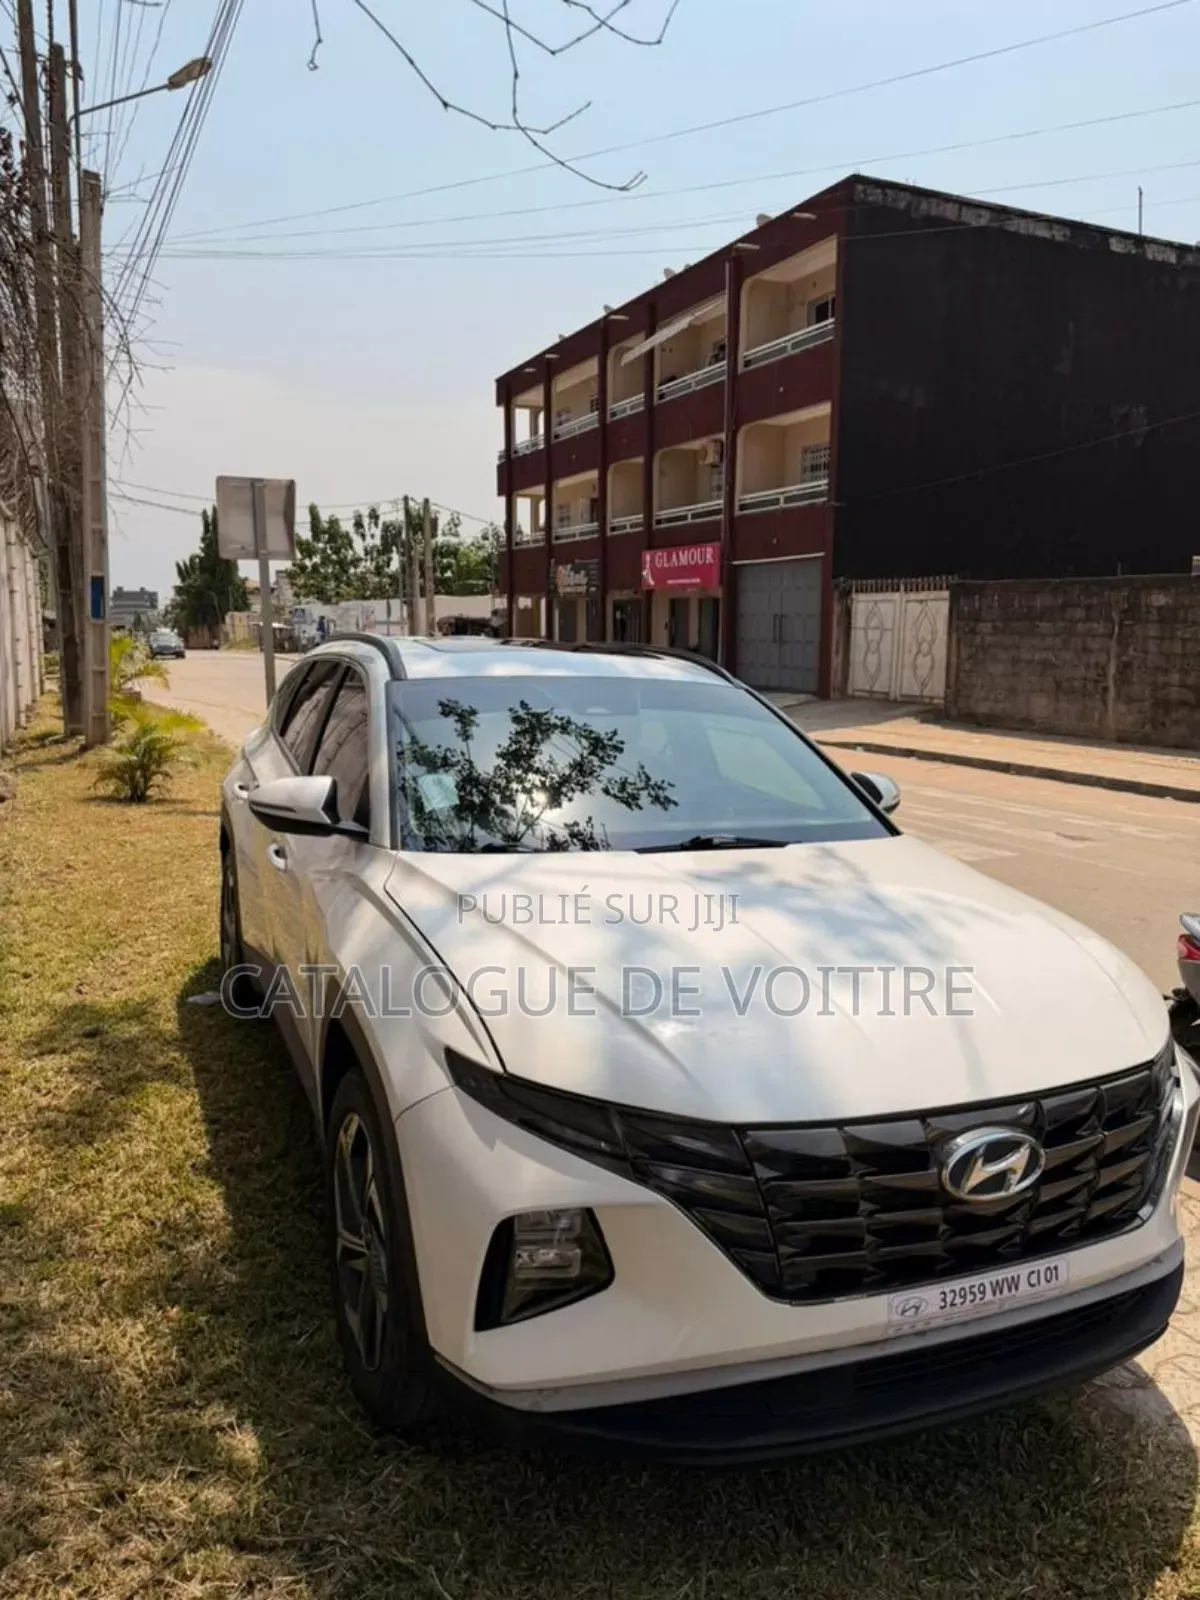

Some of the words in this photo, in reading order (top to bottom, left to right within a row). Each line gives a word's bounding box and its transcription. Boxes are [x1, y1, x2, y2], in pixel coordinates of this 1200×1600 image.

[655, 547, 714, 568] GLAMOUR
[939, 1282, 986, 1310] 32959
[989, 1274, 1021, 1297] WW
[1027, 1269, 1041, 1288] CI
[1044, 1265, 1059, 1283] 01
